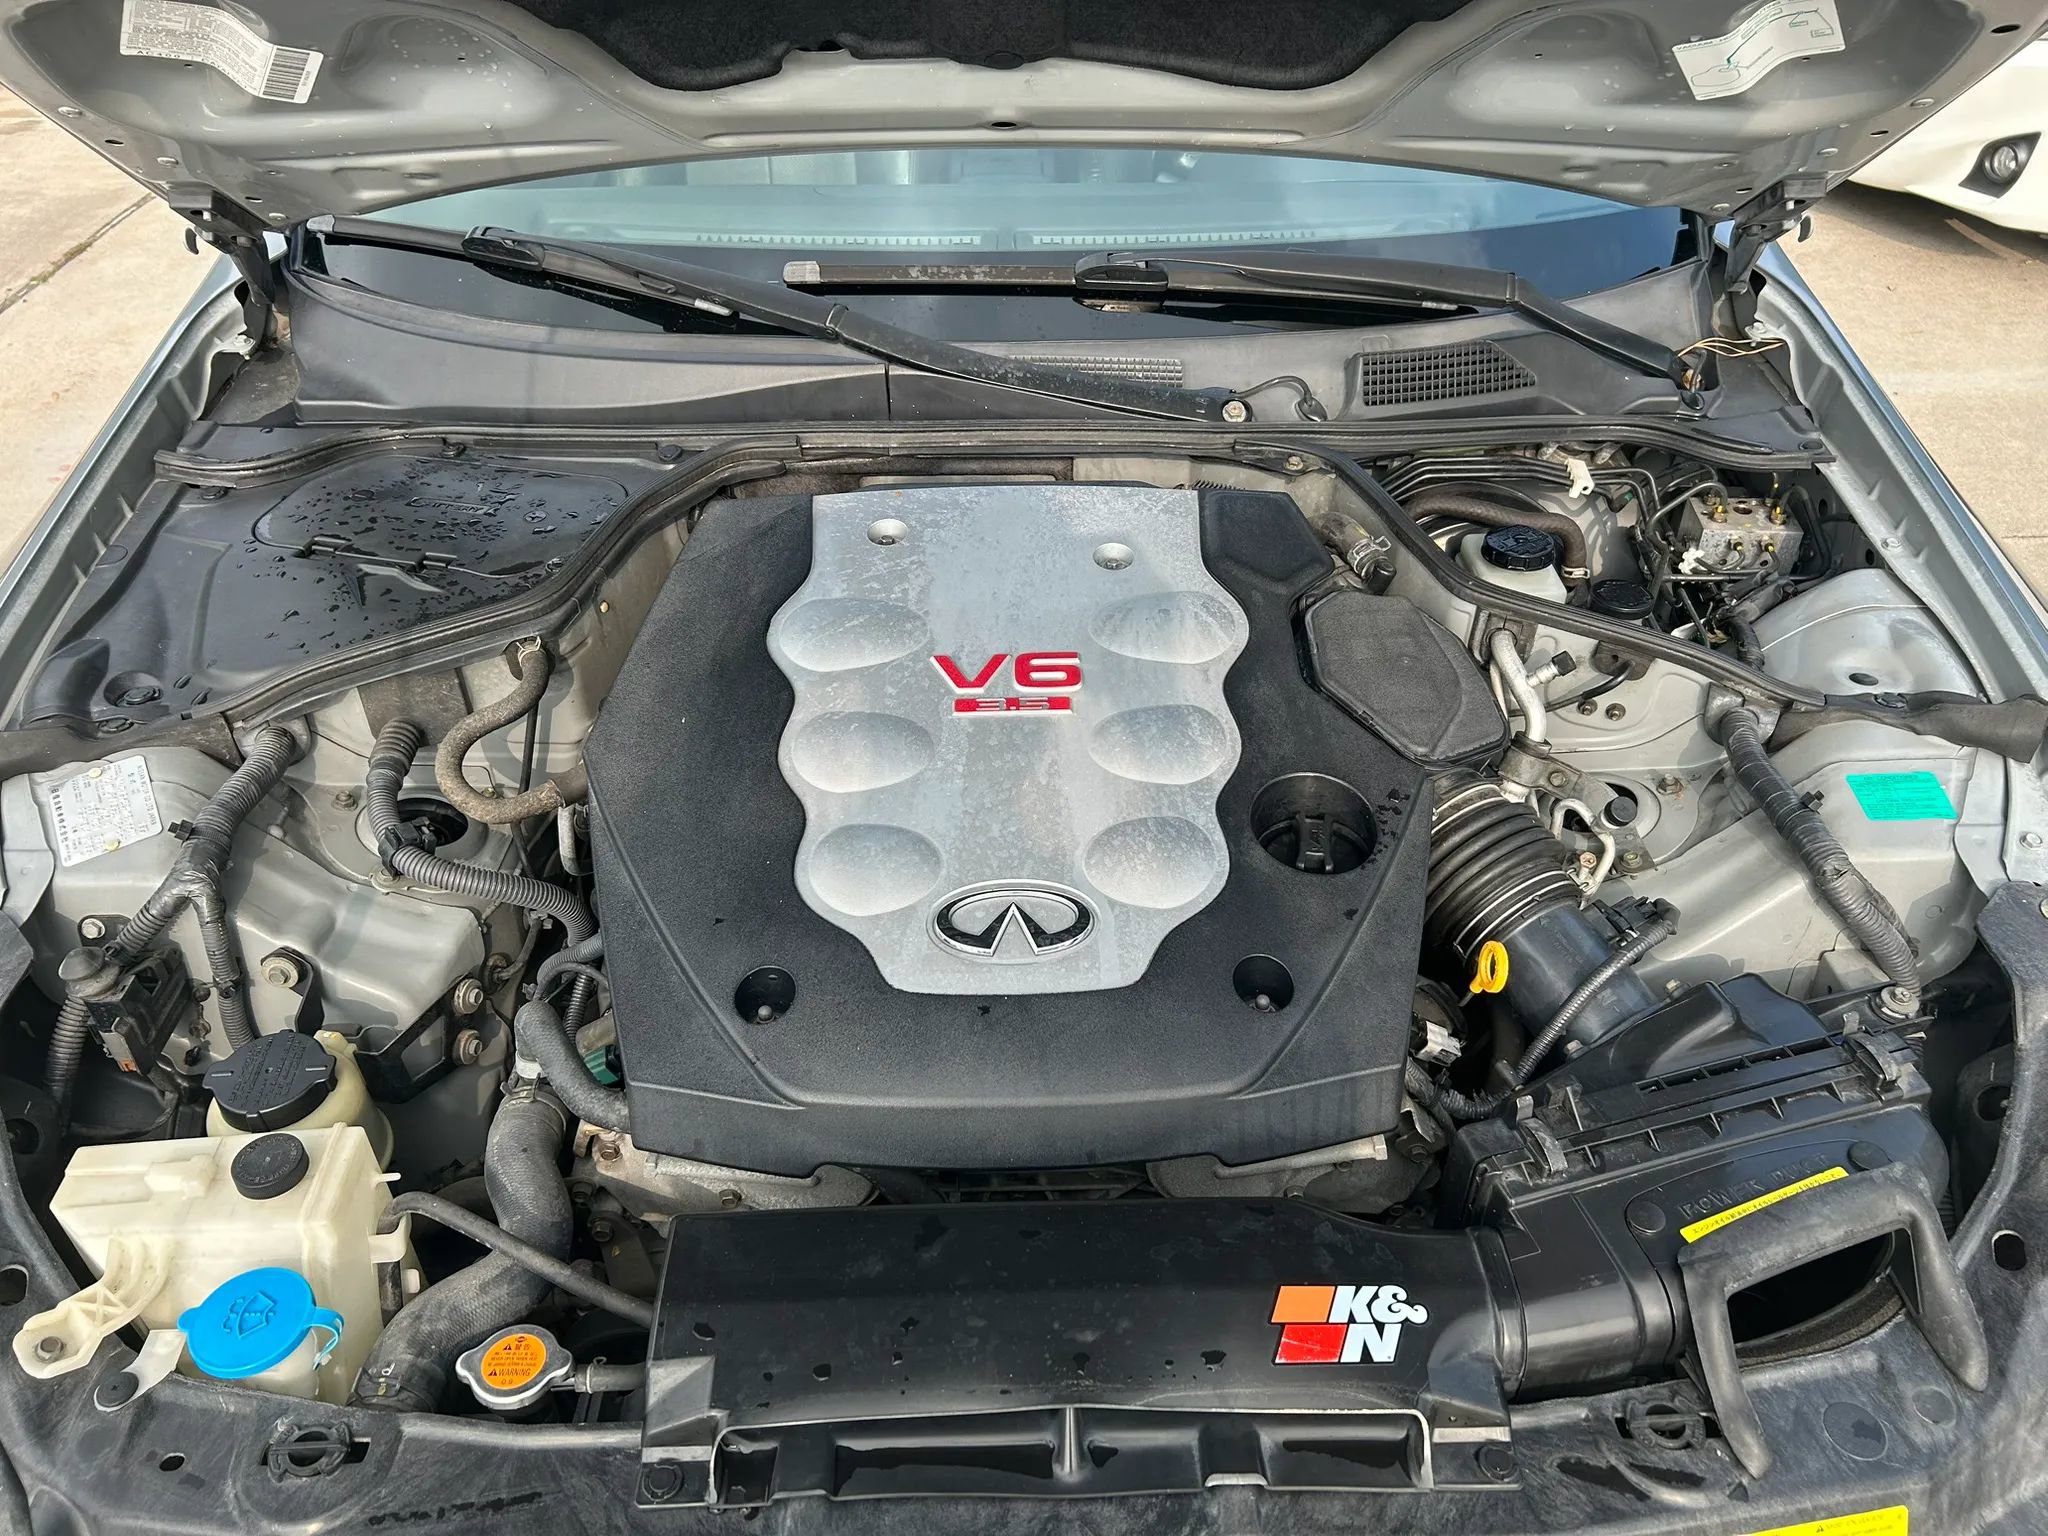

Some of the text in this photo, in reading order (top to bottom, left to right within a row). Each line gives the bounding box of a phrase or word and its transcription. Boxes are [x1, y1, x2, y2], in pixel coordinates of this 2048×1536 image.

[930, 652, 1082, 694] V6
[976, 697, 1050, 711] 3.5
[1679, 1154, 1828, 1219] POWER DUCT
[498, 1367, 531, 1377] WARNING
